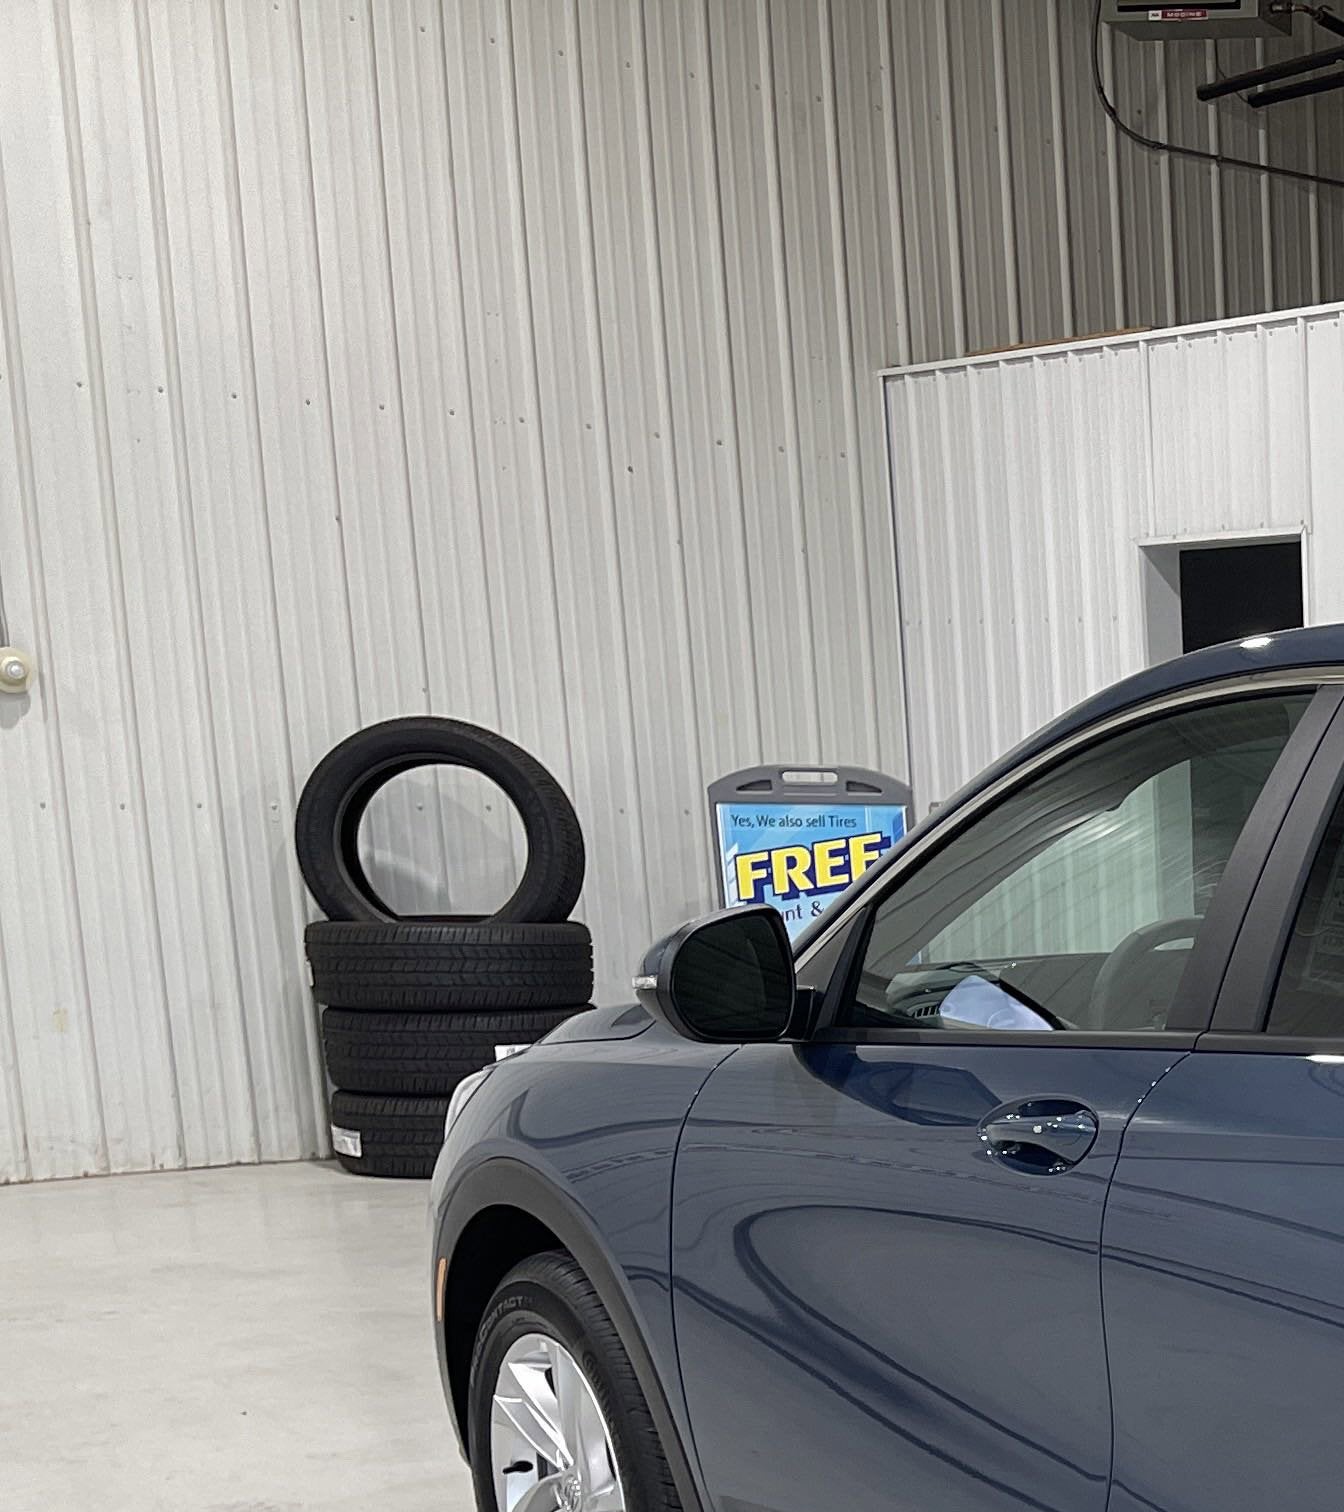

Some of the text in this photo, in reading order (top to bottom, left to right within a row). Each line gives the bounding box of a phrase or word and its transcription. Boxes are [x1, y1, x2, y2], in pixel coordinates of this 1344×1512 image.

[731, 814, 857, 828] Yes, We also sell Tires
